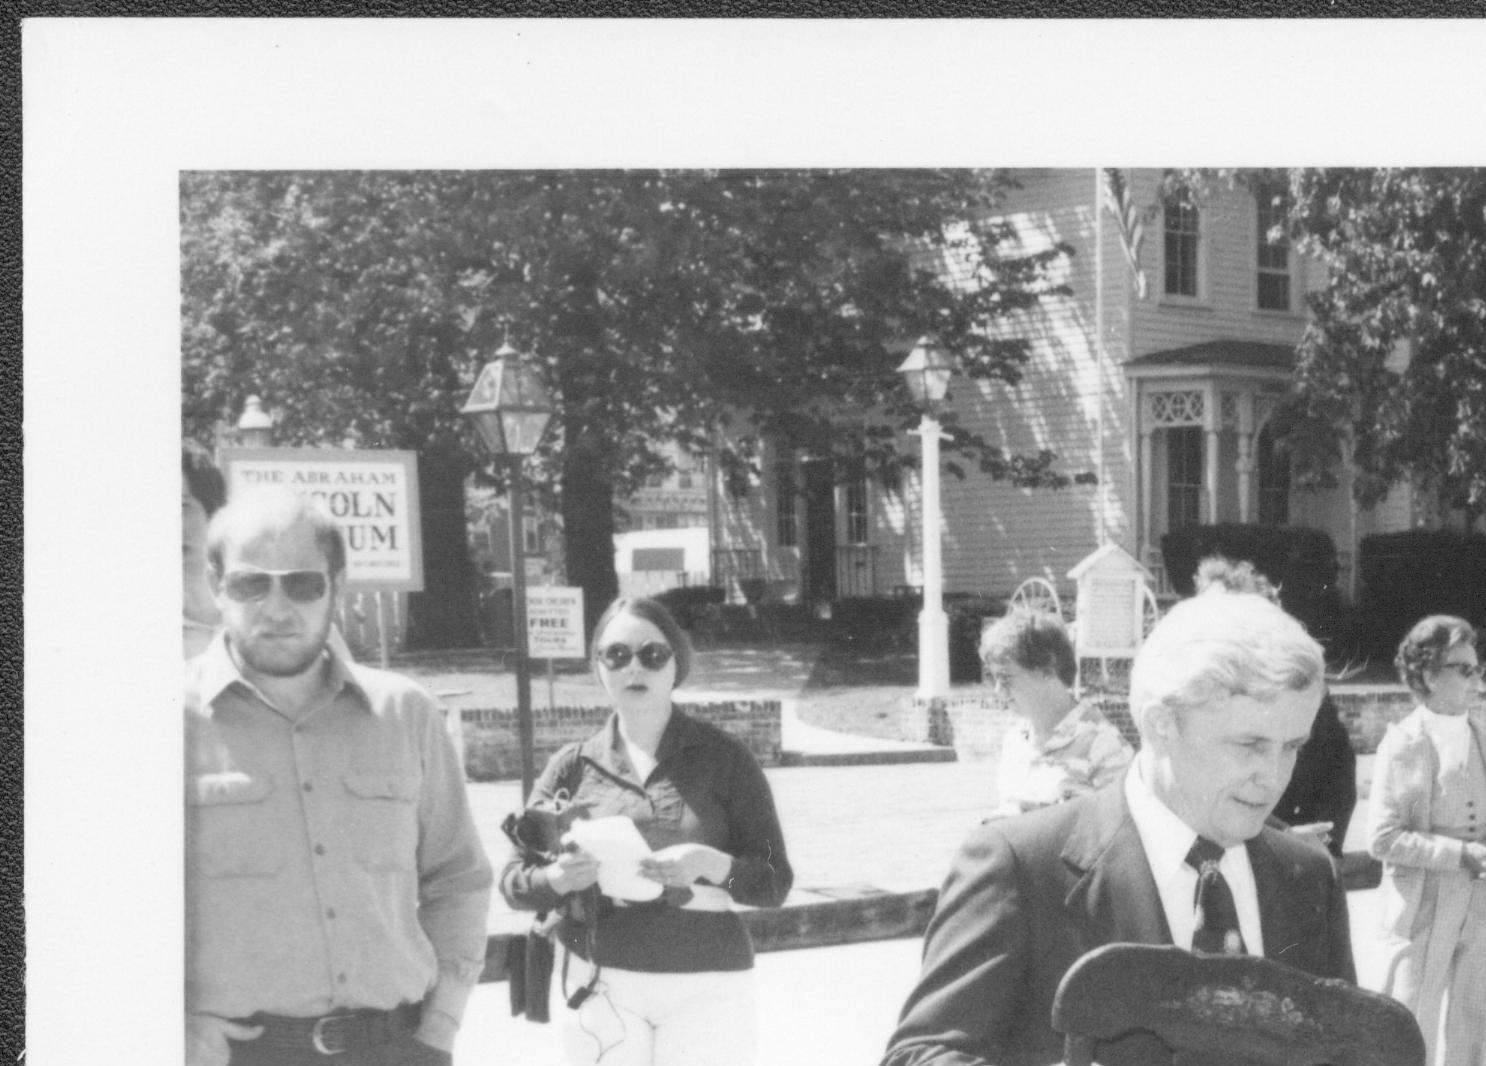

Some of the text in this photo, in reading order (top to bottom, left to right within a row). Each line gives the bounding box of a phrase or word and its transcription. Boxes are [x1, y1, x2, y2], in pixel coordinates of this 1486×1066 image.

[241, 470, 397, 484] THE ABRAHAM
[530, 618, 569, 629] FREE
